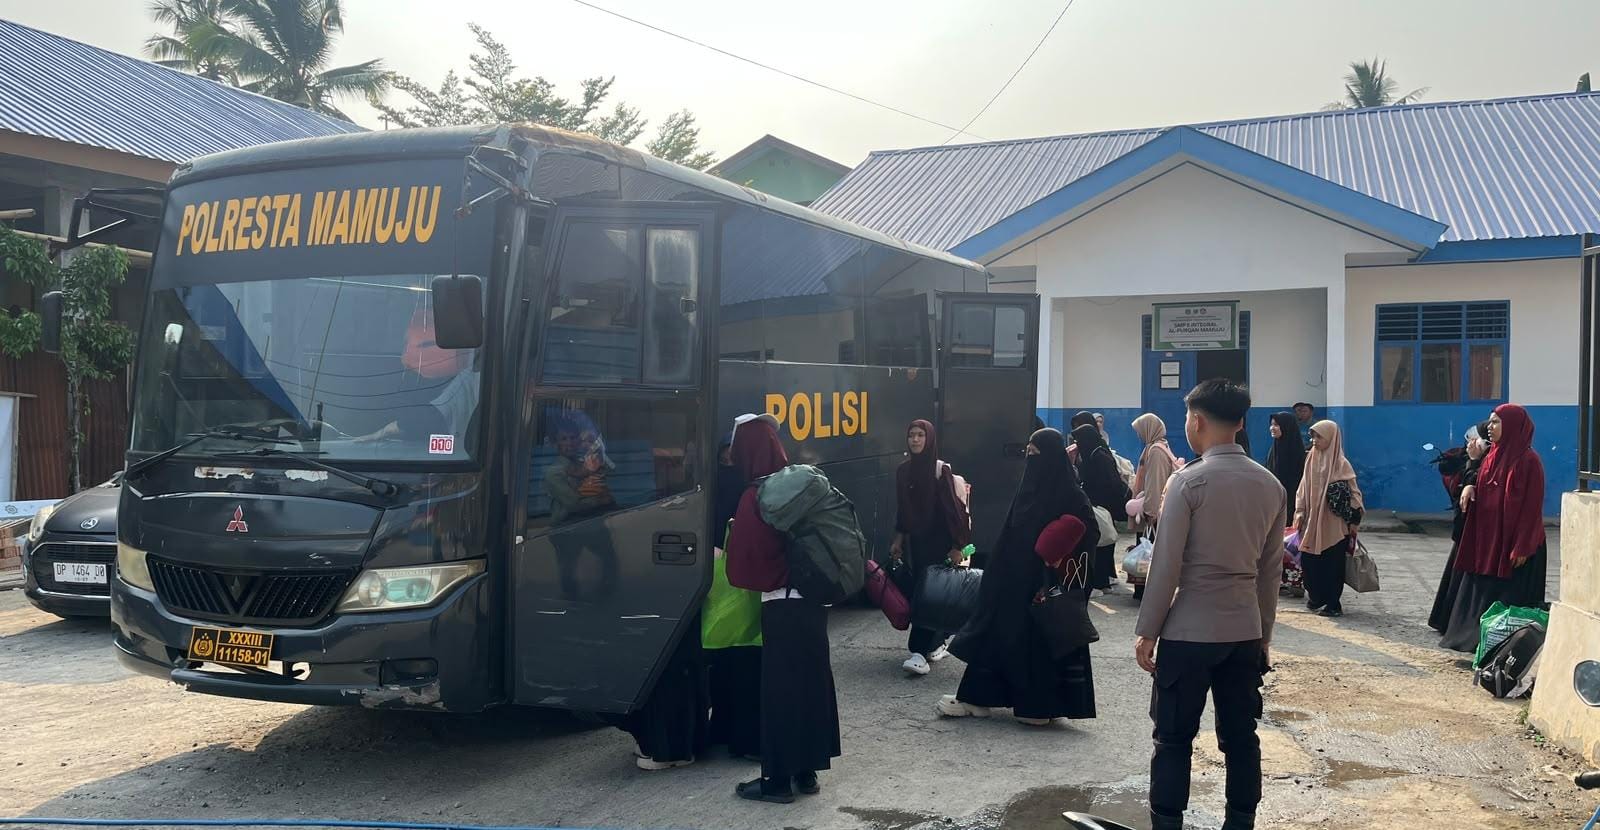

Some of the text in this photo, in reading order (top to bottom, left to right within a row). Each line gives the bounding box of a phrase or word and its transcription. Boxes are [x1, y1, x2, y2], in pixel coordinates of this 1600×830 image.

[176, 186, 442, 256] POLRESTA MAMUJU
[765, 391, 868, 441] POLISI
[432, 439, 452, 451] 110
[56, 564, 66, 575] DP
[72, 565, 90, 576] 1464
[228, 632, 263, 646] XXXIII
[219, 647, 268, 664] 11158-01
